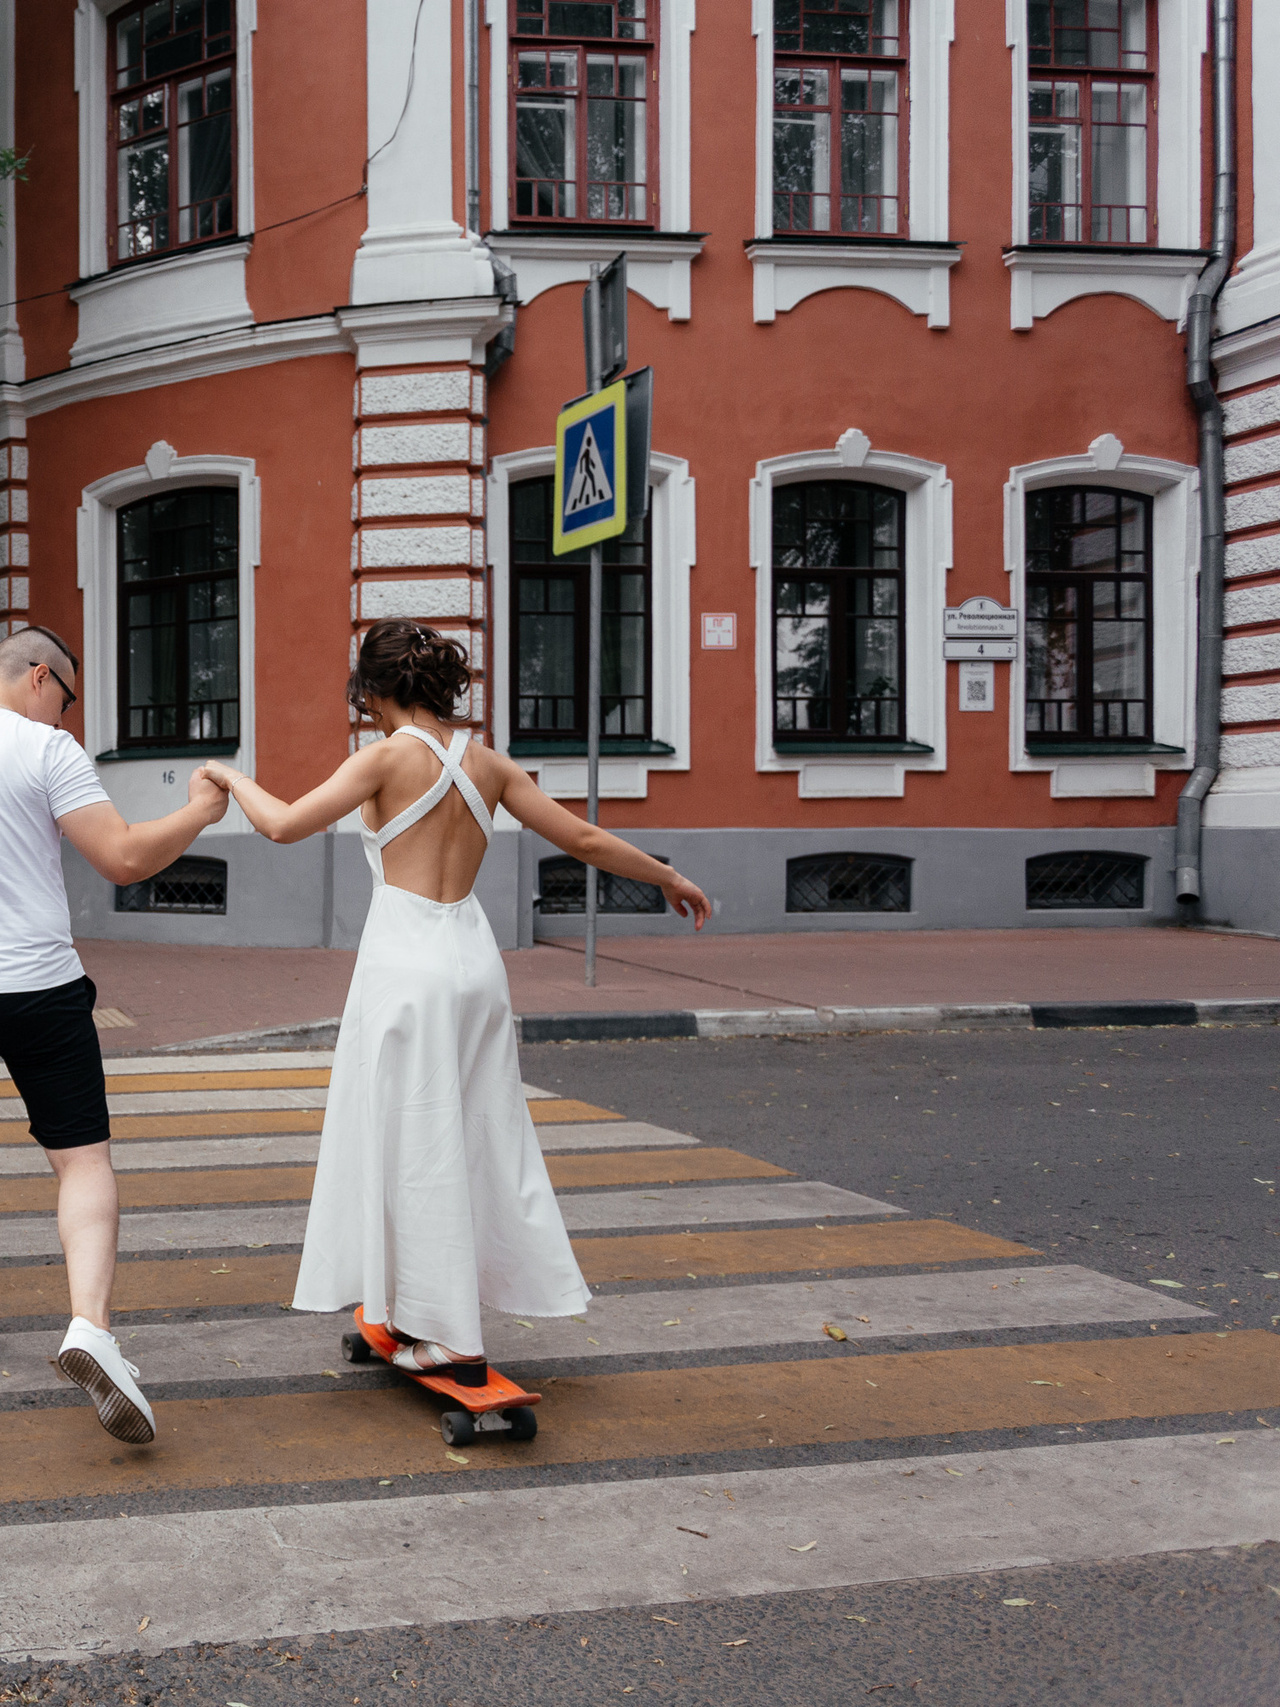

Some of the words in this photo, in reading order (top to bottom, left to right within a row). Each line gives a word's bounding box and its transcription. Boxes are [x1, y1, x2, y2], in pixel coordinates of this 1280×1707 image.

[959, 612, 1016, 621] Революционная
[977, 644, 984, 655] 4
[162, 770, 175, 784] 16
